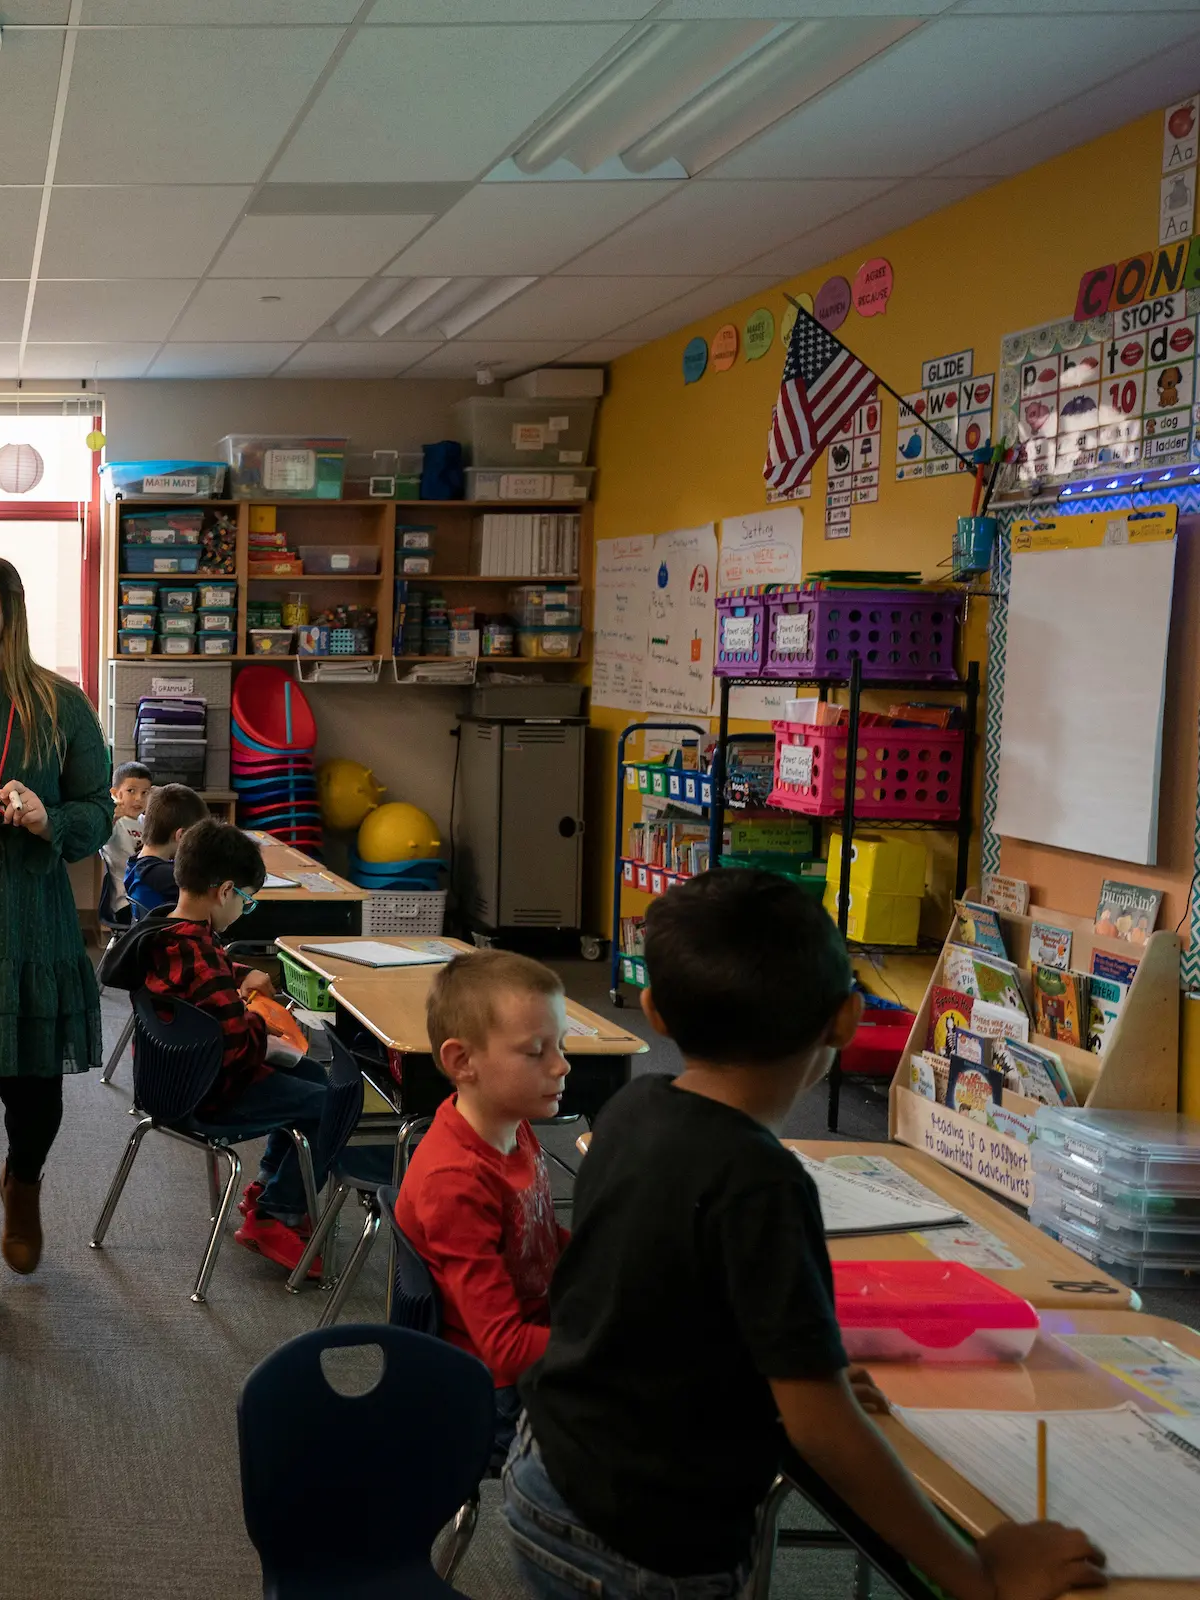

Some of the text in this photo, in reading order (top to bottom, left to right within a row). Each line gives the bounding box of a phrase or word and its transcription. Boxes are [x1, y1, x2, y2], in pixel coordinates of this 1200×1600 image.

[1168, 144, 1193, 167] Aa
[1165, 216, 1188, 239] Aa
[865, 266, 887, 284] AGREE
[857, 287, 888, 307] BECAUSE
[818, 301, 846, 319] HAPPEN
[1121, 297, 1174, 330] STOPS
[1107, 341, 1119, 373] t
[1150, 326, 1169, 362] d
[928, 357, 964, 382] GLIDE
[1109, 380, 1137, 414] 10
[1160, 415, 1179, 429] dog
[1155, 436, 1188, 452] ladder
[274, 454, 306, 464] SHAPES
[935, 462, 949, 472] web
[145, 478, 195, 488] MATH MATS
[859, 475, 874, 485] lamp
[833, 490, 870, 504] mirror bell
[832, 510, 847, 519] write
[742, 520, 774, 540] Setting
[831, 526, 849, 536] rhyme
[726, 626, 750, 635] Power Goal
[779, 623, 805, 633] Power Goal
[729, 639, 746, 647] Activities
[782, 637, 800, 646] Activities
[783, 755, 810, 767] Power Goal
[785, 767, 805, 778] Activities
[1100, 890, 1157, 912] pumpkin?
[931, 1112, 1028, 1171] Reading is a passport
[925, 1130, 934, 1149] to
[937, 1140, 974, 1170] countless
[978, 1160, 1030, 1198] adventures
[1046, 1279, 1119, 1294] 18
